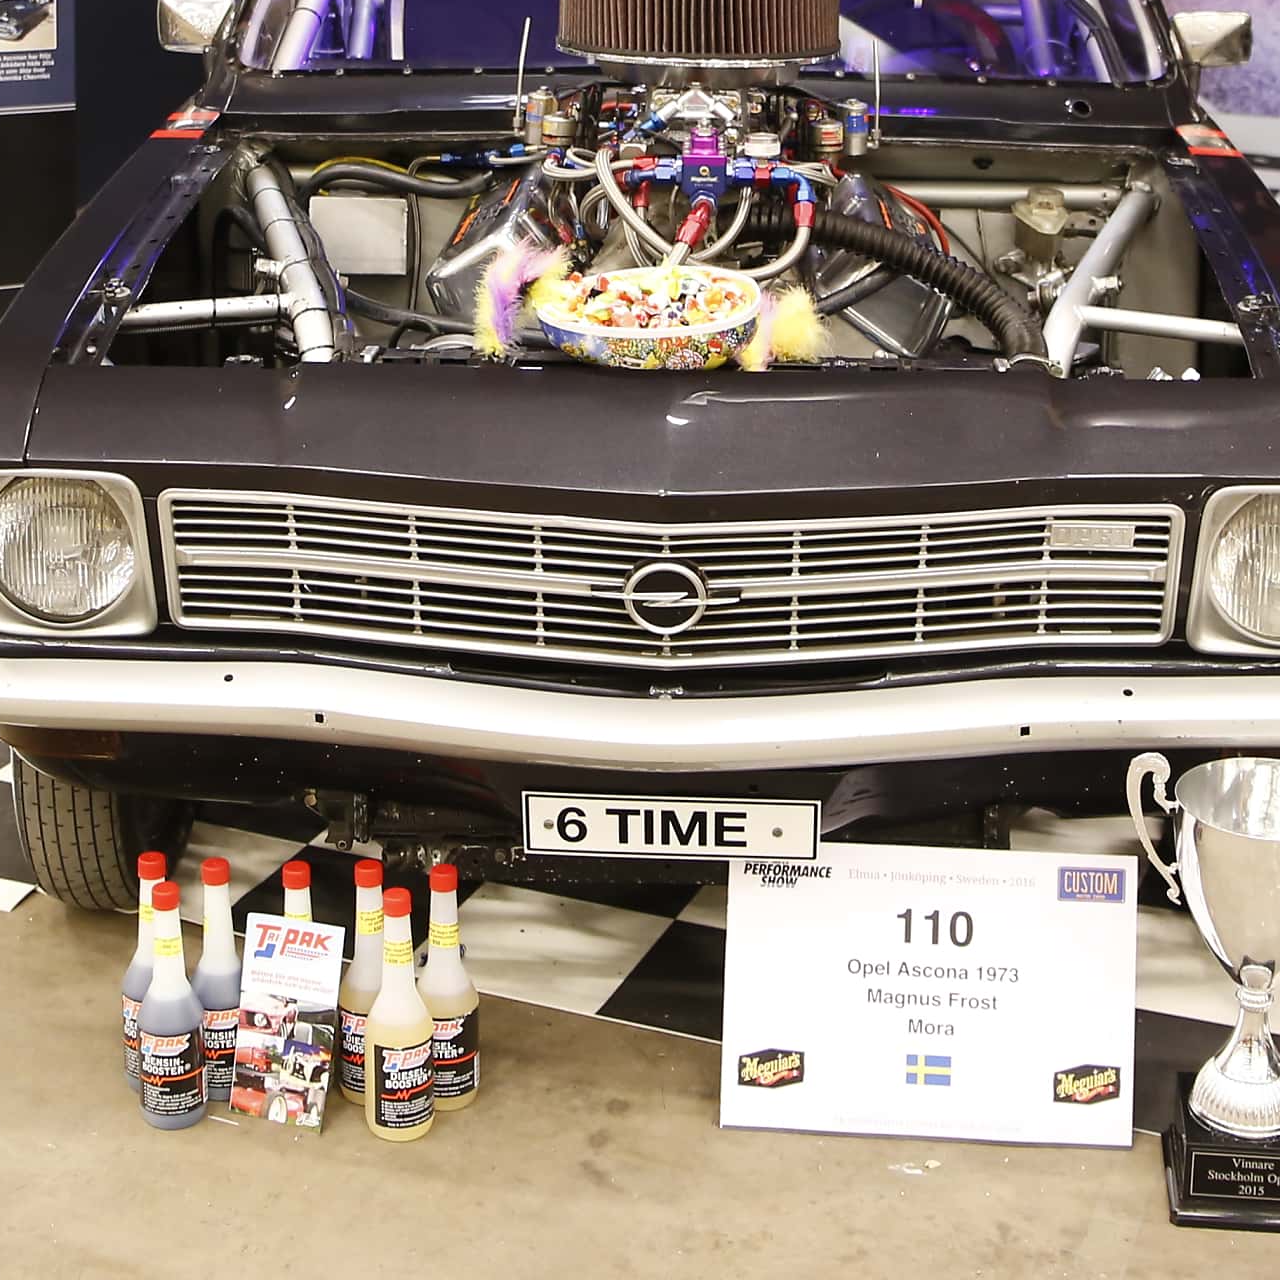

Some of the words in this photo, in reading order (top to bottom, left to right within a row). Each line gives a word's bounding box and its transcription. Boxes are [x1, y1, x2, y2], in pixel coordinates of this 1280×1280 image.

[557, 807, 587, 842] 6
[606, 808, 748, 848] TIME
[744, 862, 832, 880] PERFORMANCE
[760, 875, 798, 889] SHOW
[1064, 871, 1118, 895] CUSTOM
[896, 908, 974, 948] 110
[847, 959, 891, 979] Opel
[898, 962, 969, 981] Ascona
[976, 966, 1020, 984] 1973
[867, 989, 942, 1009] Magnus
[949, 993, 998, 1011] Frost
[205, 1030, 235, 1041] ENSIN
[908, 1019, 955, 1037] Mora
[1232, 1157, 1274, 1171] Vinnare
[1207, 1170, 1264, 1183] Stockholm
[1238, 1184, 1264, 1197] 2015
